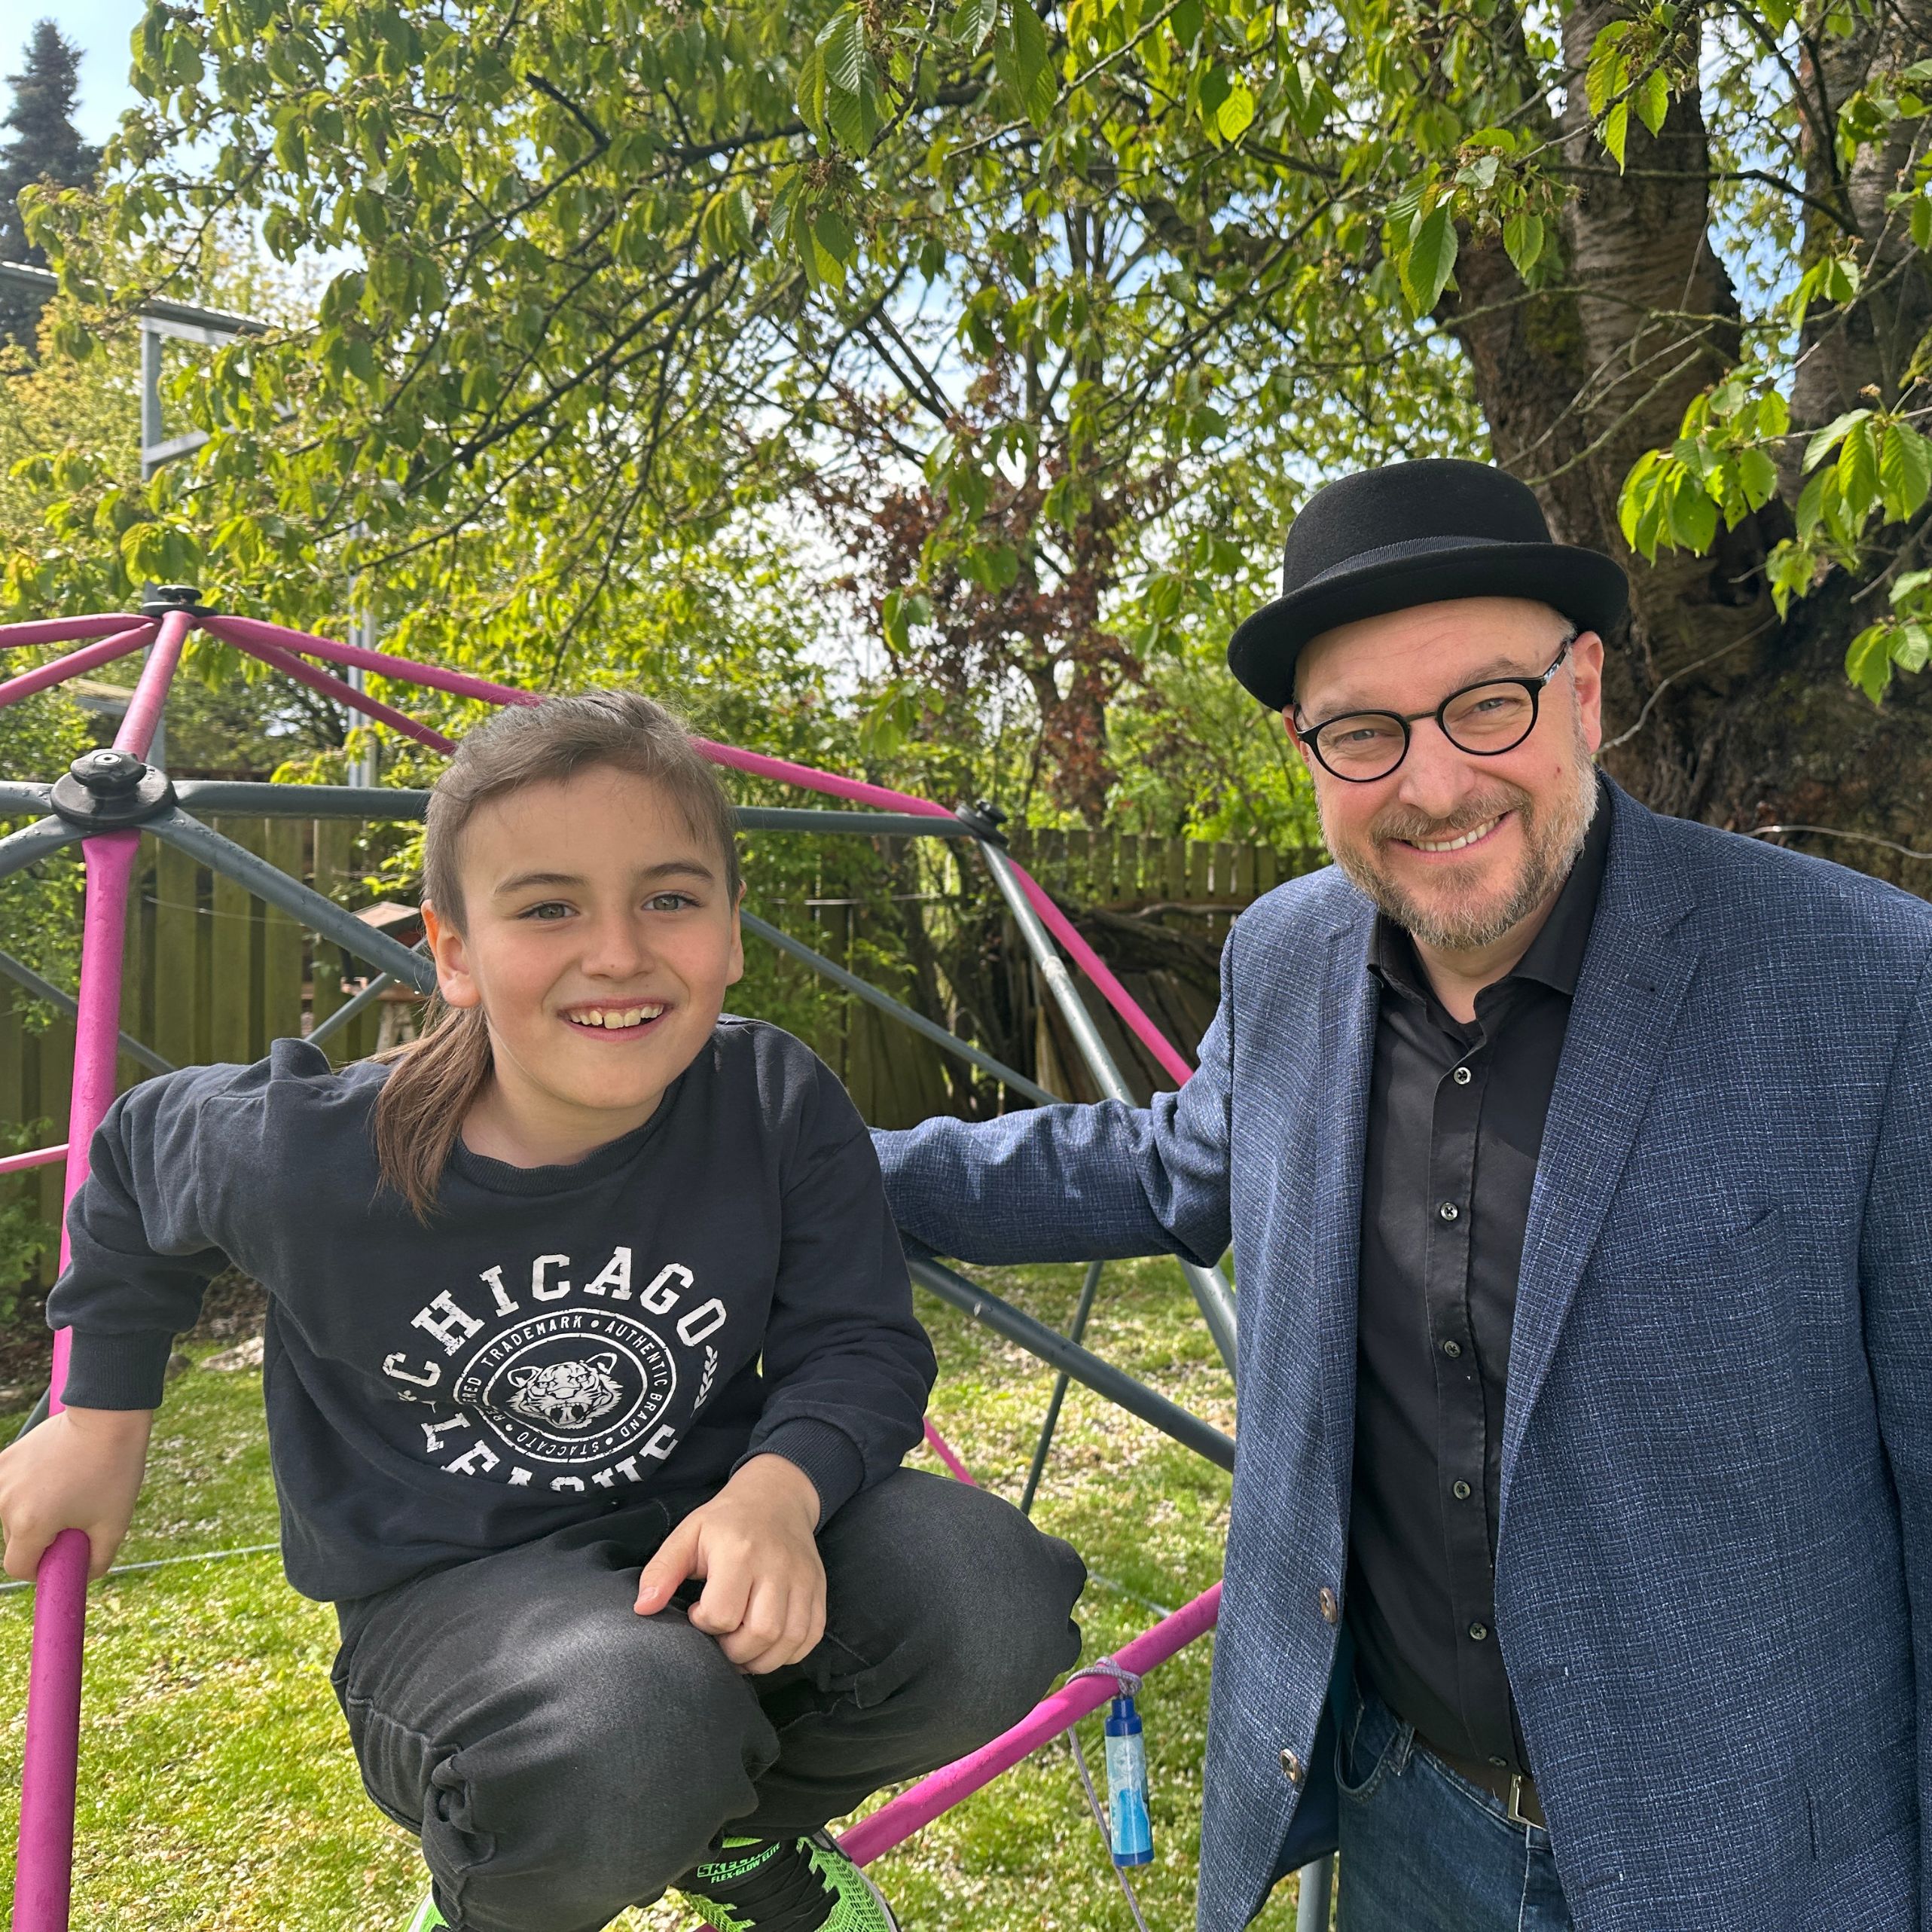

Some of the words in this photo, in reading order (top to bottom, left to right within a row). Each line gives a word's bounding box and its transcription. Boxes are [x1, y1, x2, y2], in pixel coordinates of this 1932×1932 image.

[383, 1246, 727, 1387] CHICAGO
[481, 1314, 582, 1367] TRADEMARK
[605, 1320, 668, 1386] AUTHENTIC
[620, 1393, 663, 1437] BRAND
[517, 1432, 599, 1456] STACCATO
[710, 1858, 761, 1884] FLEX-GLOW
[762, 1843, 780, 1863] ELITE
